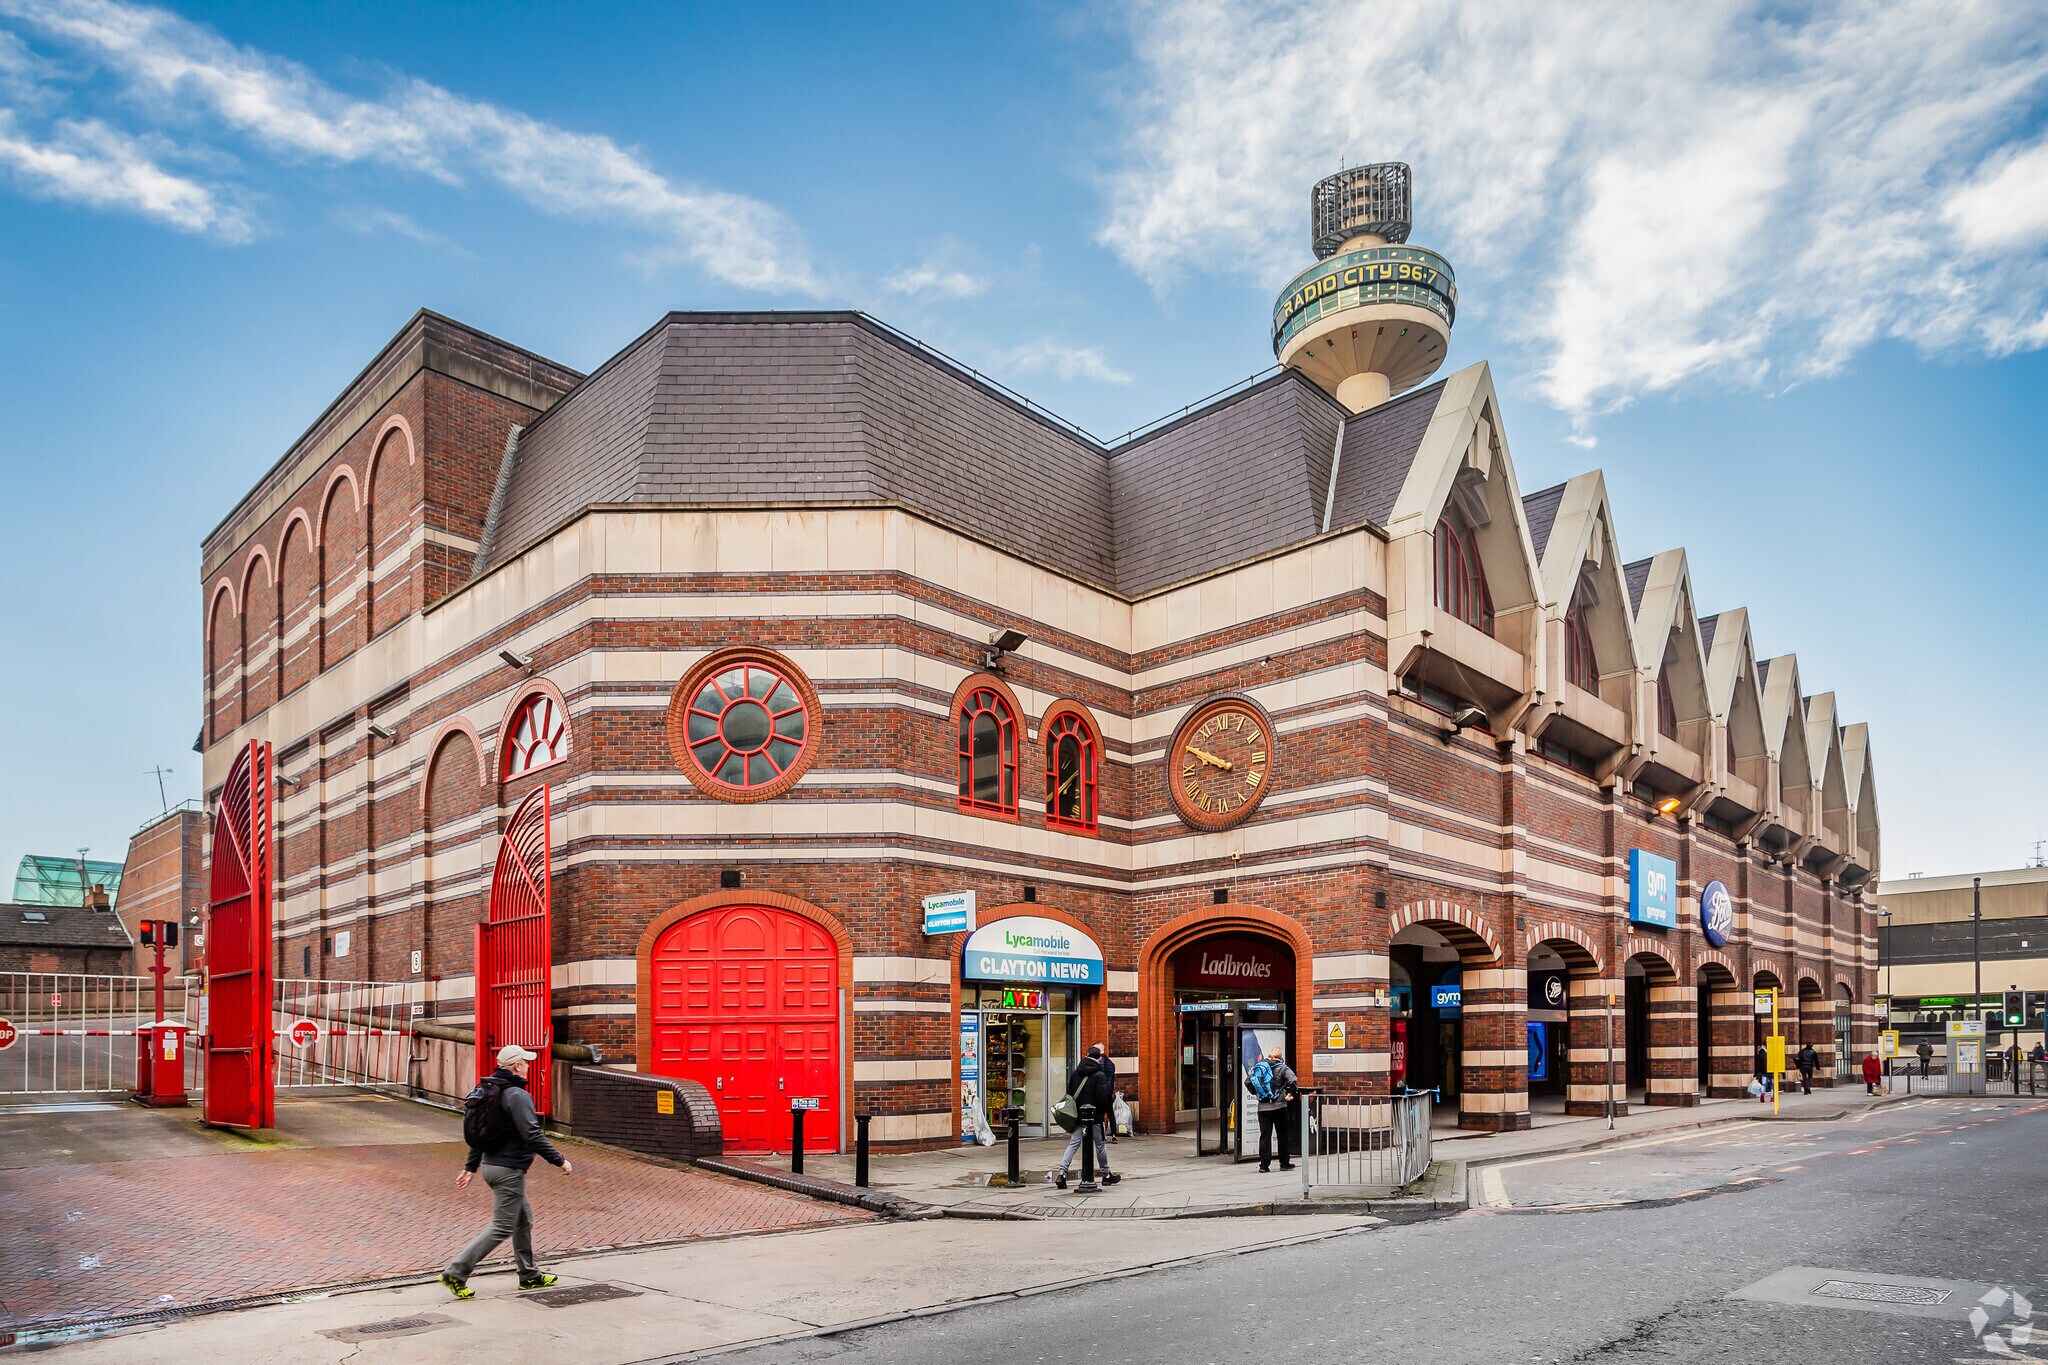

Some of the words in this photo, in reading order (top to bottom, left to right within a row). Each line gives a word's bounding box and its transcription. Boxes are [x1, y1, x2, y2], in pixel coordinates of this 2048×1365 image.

[1284, 276, 1337, 318] RADIO
[1344, 263, 1392, 285] CITY
[1647, 870, 1666, 897] gym
[928, 898, 965, 910] Lycamobile
[928, 919, 951, 928] CLAYTON
[951, 917, 966, 925] NEWS
[1006, 930, 1070, 949] Lycamobile
[980, 957, 1046, 977] CLAYTON
[1051, 962, 1089, 979] NEWS
[1201, 952, 1271, 978] Ladbrokes
[1437, 992, 1460, 1005] gym
[0, 1029, 14, 1040] OP
